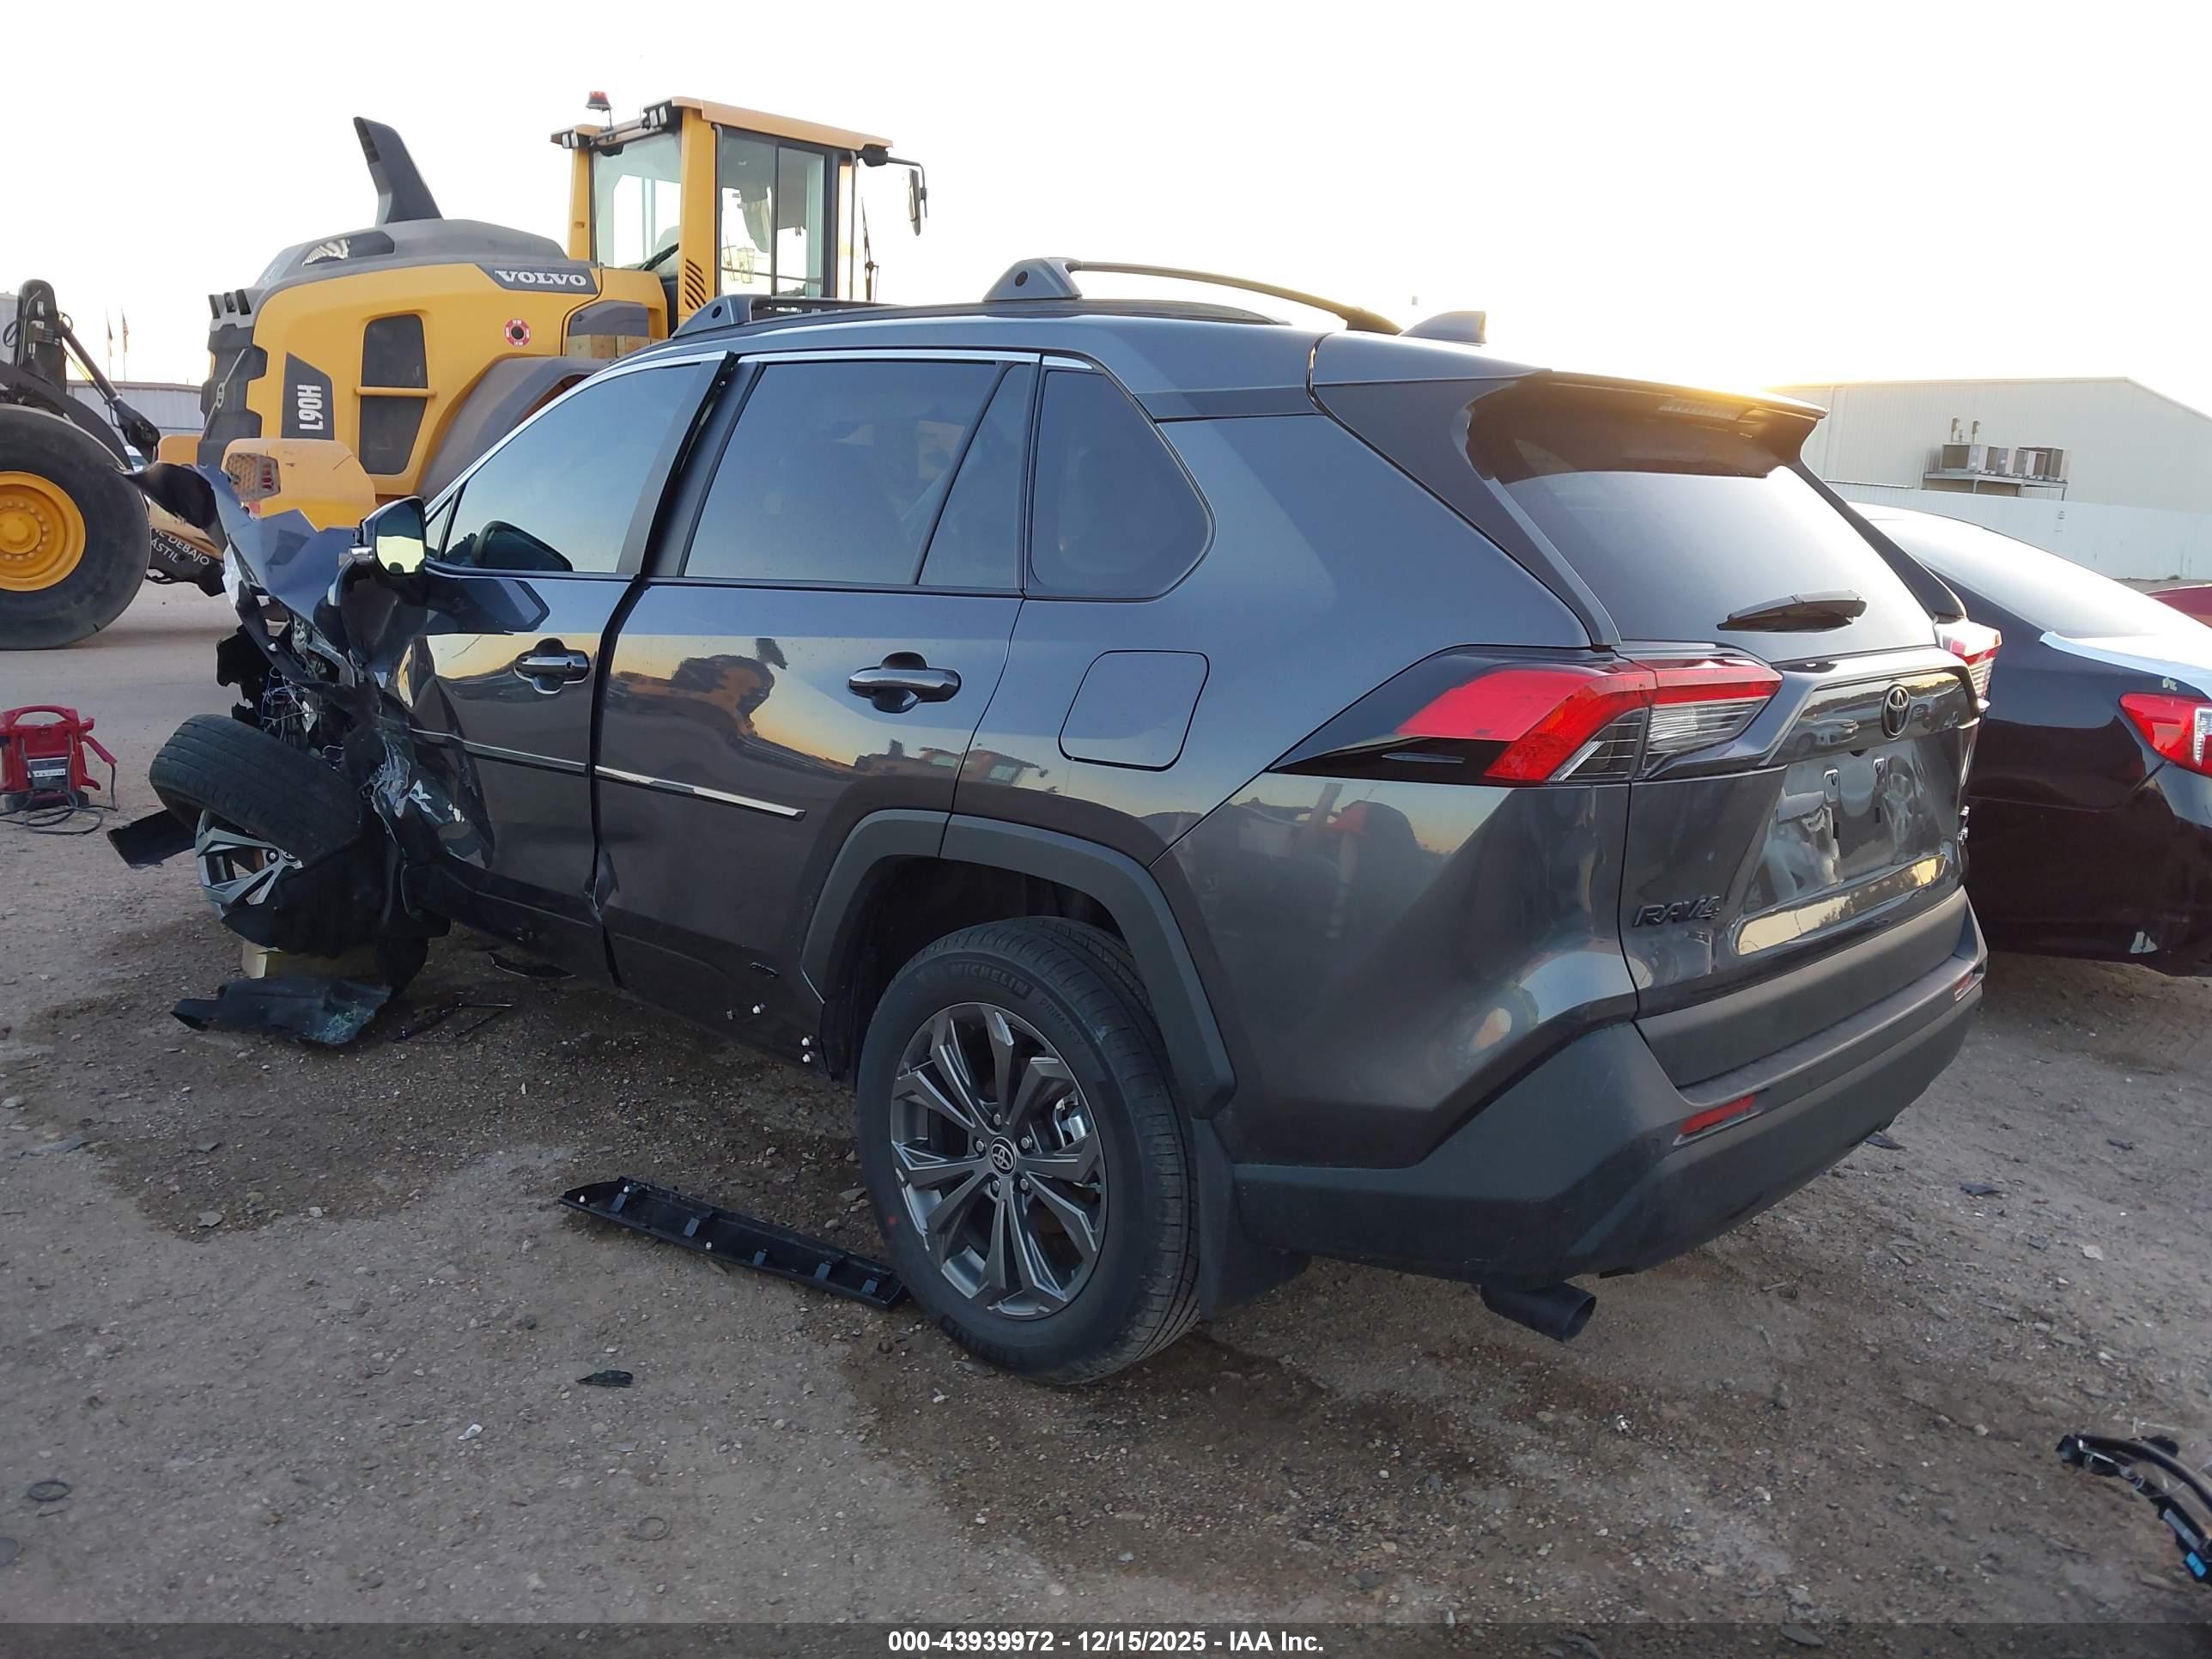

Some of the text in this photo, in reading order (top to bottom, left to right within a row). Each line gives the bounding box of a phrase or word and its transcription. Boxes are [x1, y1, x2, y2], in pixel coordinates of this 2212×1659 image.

[495, 270, 586, 286] VOLVO
[297, 385, 324, 430] L90H
[150, 537, 178, 563] ÁSTIL
[167, 537, 210, 565] DEBAJO
[1633, 895, 1721, 927] RAV4
[948, 963, 1030, 998] MICHELIN
